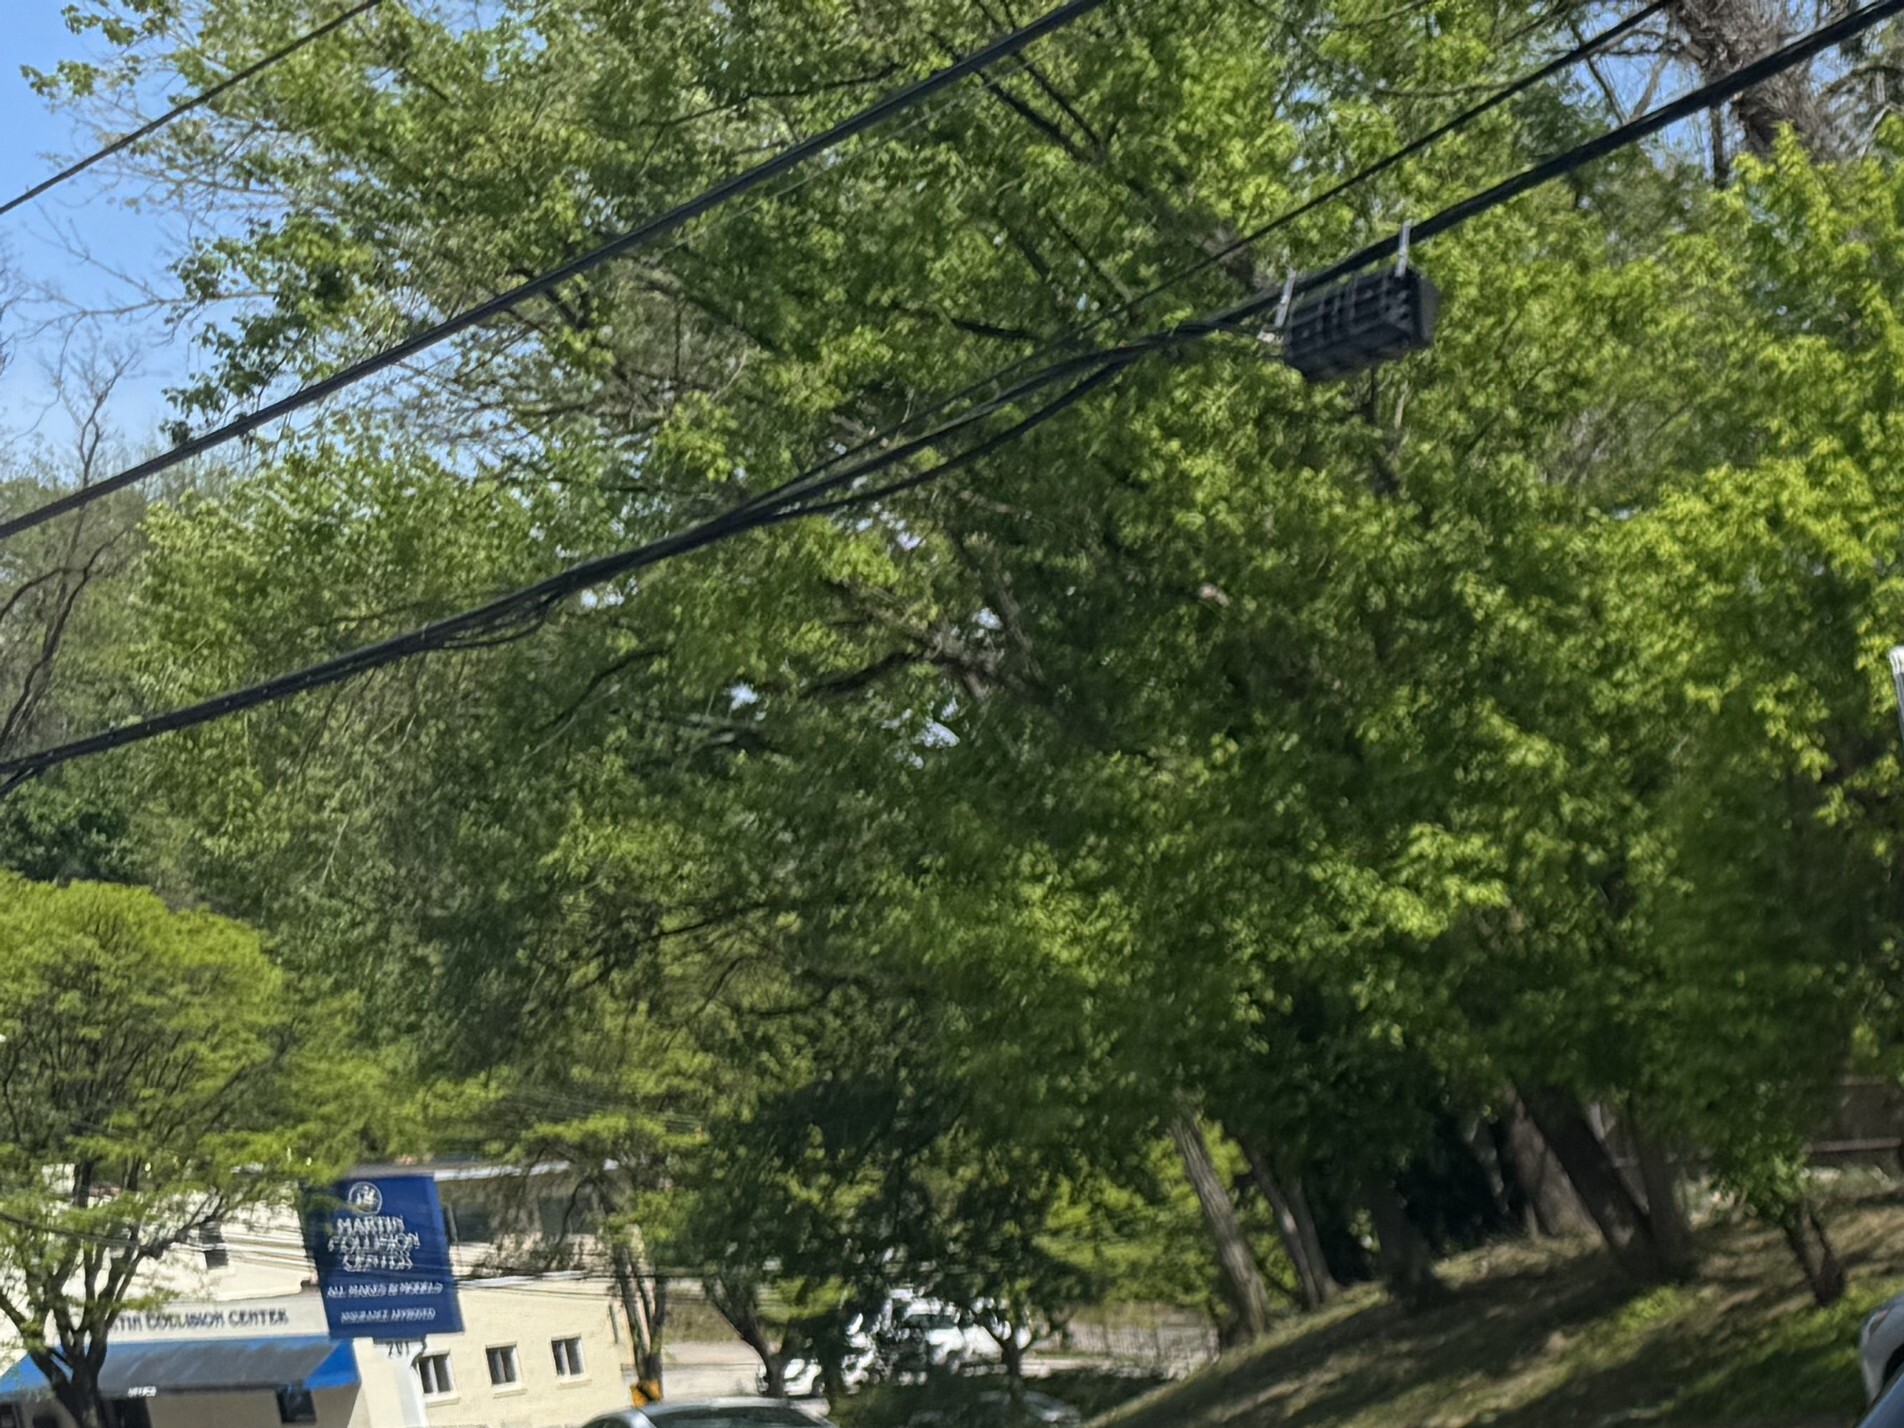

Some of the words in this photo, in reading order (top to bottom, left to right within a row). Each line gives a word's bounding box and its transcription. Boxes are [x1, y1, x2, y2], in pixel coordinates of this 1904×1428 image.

[337, 1215, 405, 1236] MARTIN
[327, 1232, 420, 1253] COLLISION
[147, 1311, 226, 1331] COLLISION
[228, 1309, 289, 1328] CENTER
